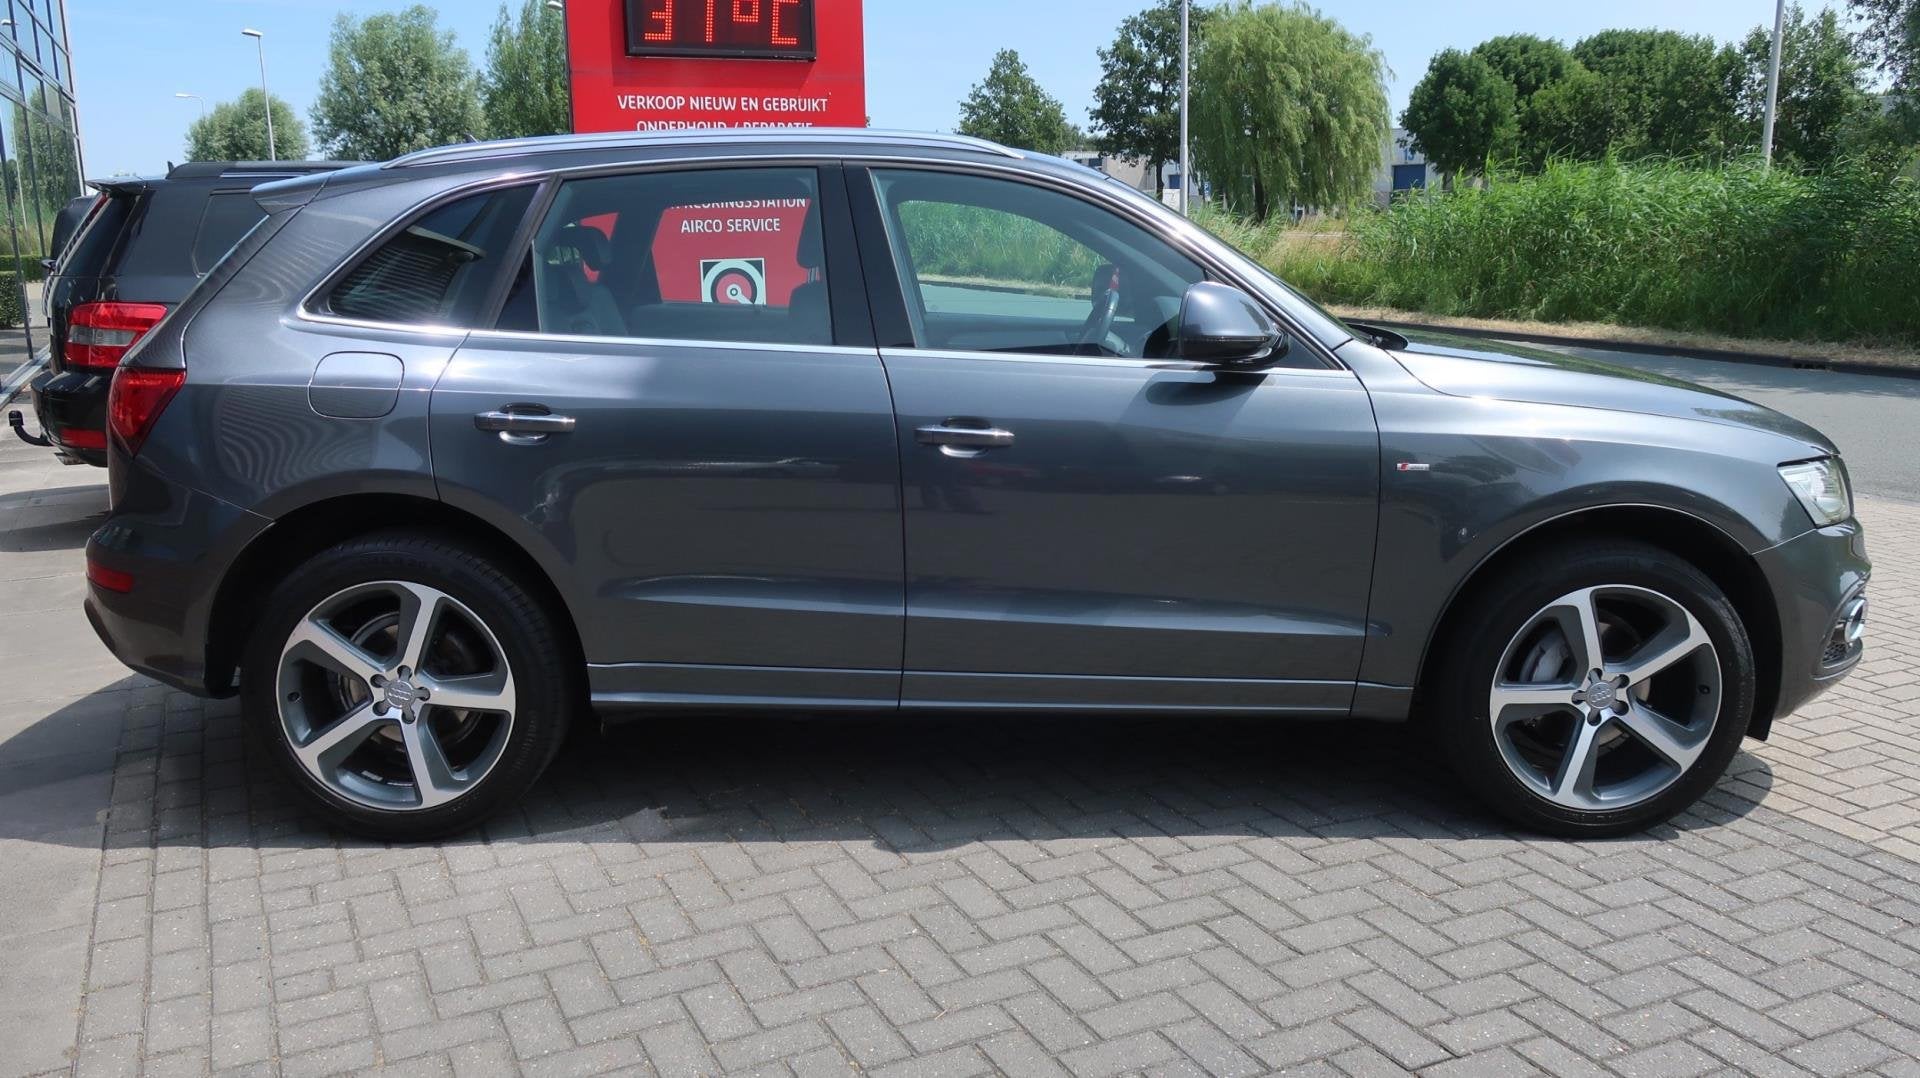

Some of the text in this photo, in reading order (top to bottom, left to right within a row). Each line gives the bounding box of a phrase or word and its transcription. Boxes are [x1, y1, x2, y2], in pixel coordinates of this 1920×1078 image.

[617, 95, 828, 112] VERKOOP NIEUW EN GEBRUIKT
[681, 218, 781, 233] AIRCO SERVICE
